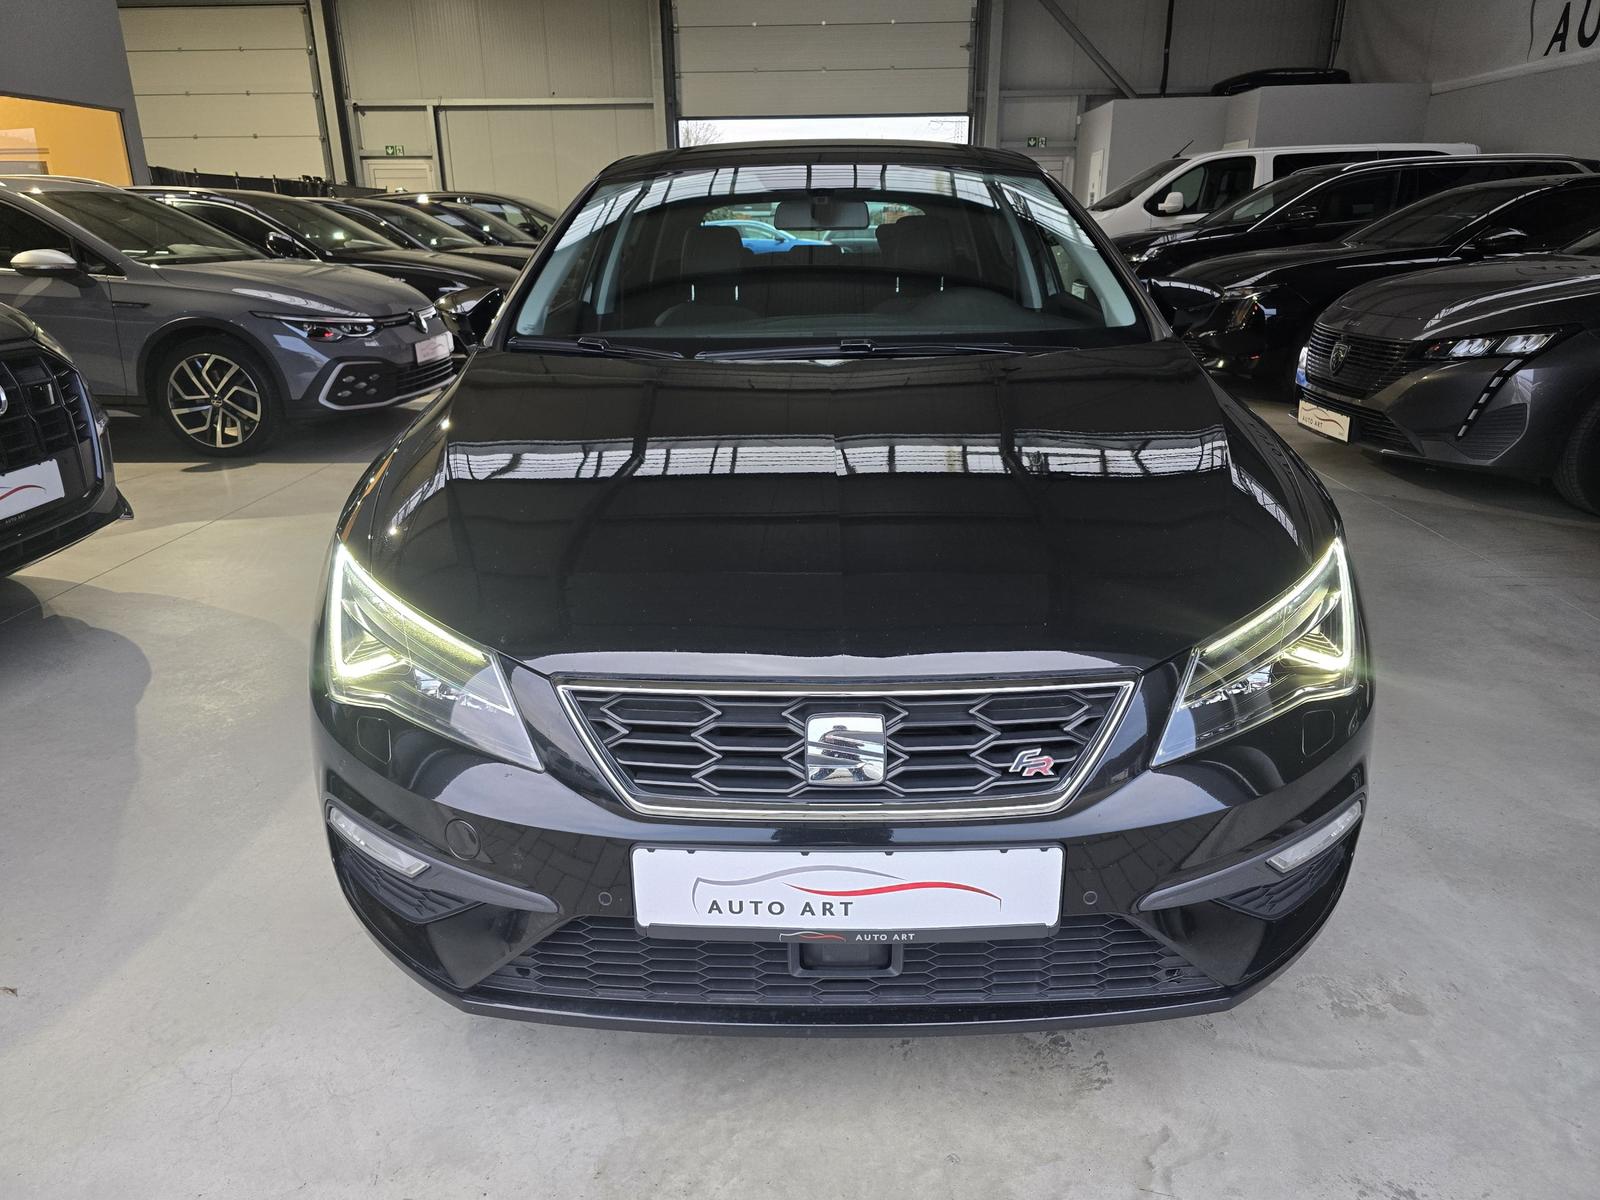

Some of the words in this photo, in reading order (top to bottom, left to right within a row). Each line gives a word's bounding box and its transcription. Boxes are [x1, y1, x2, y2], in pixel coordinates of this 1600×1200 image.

[1543, 0, 1600, 56] AU
[1009, 748, 1054, 776] FR
[707, 899, 785, 915] AUTO
[800, 901, 853, 916] ART
[855, 933, 888, 941] AUTO
[892, 933, 915, 941] ART
